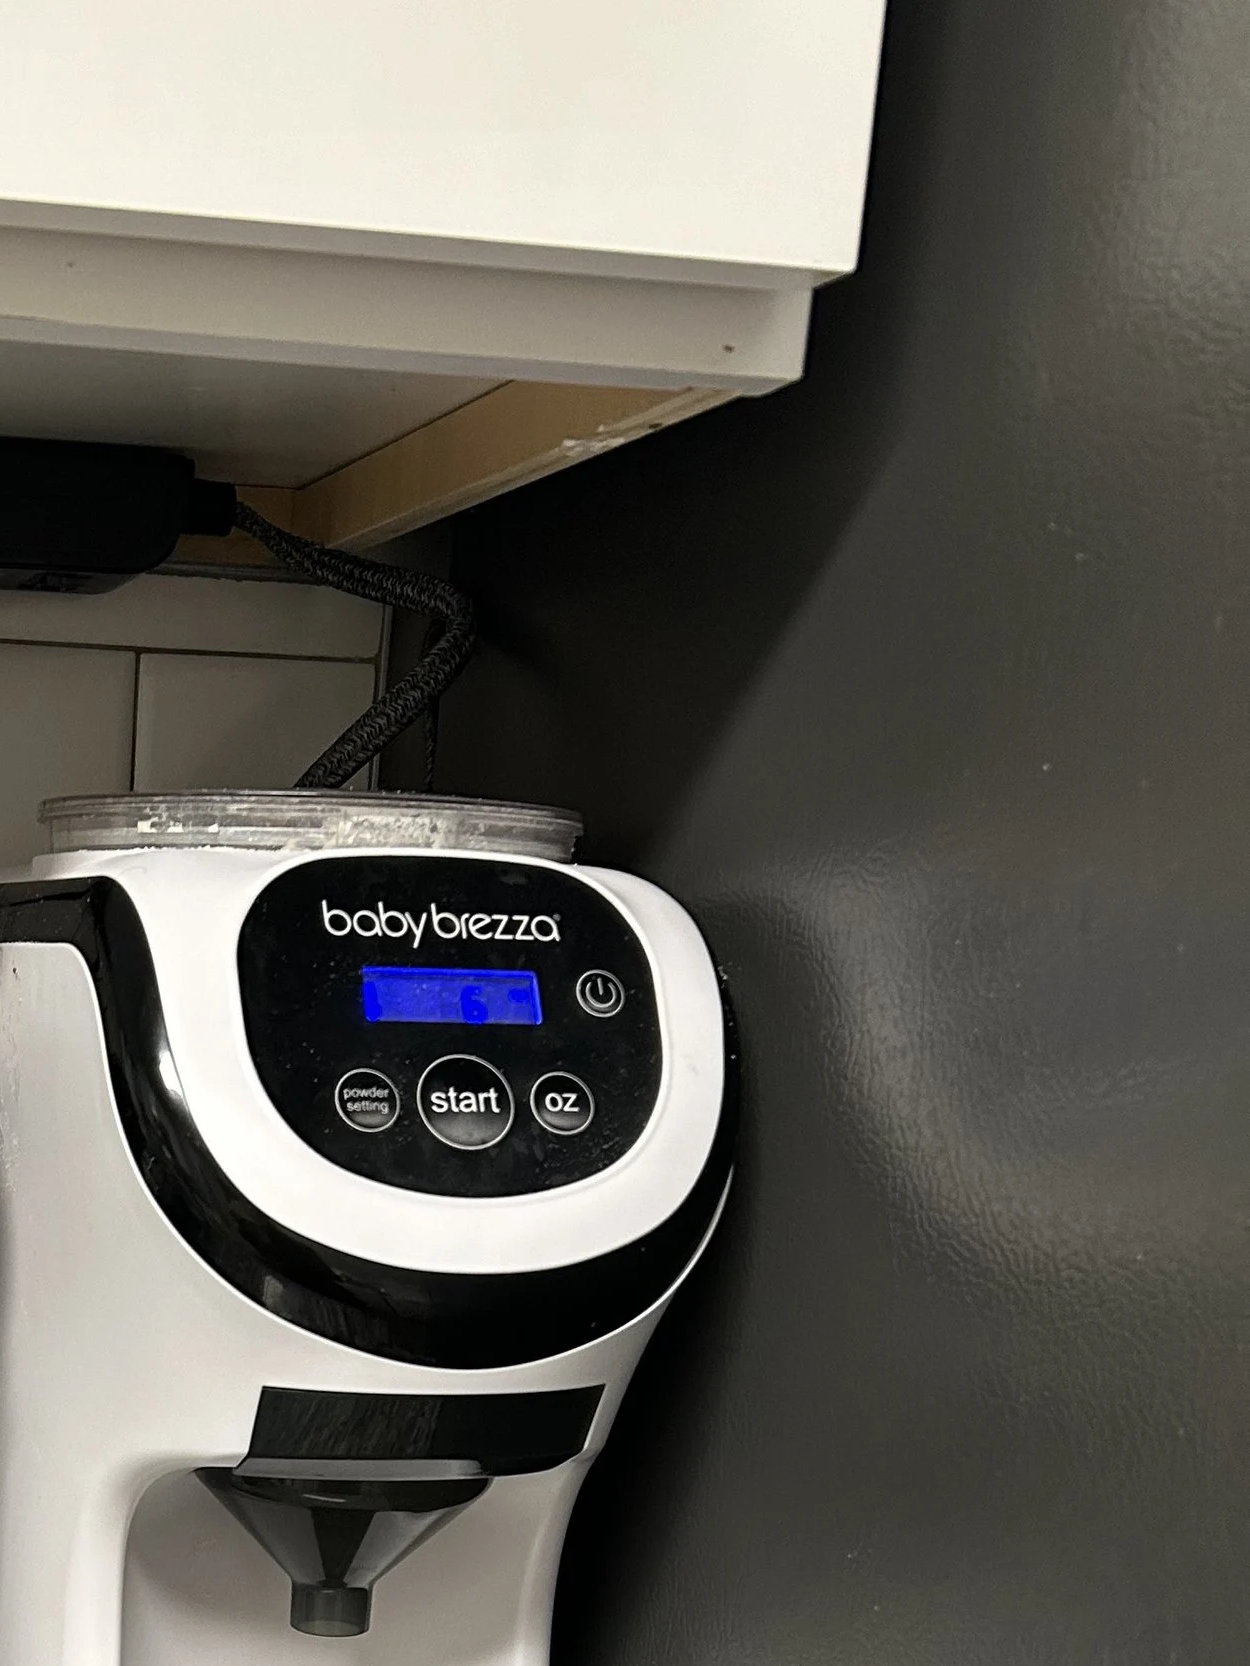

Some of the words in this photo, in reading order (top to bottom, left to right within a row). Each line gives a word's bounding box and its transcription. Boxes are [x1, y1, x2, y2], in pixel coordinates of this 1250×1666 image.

[459, 984, 489, 1024] 6
[343, 1086, 389, 1100] powder
[430, 1087, 501, 1113] start
[544, 1092, 580, 1112] oz
[346, 1100, 389, 1115] setting
